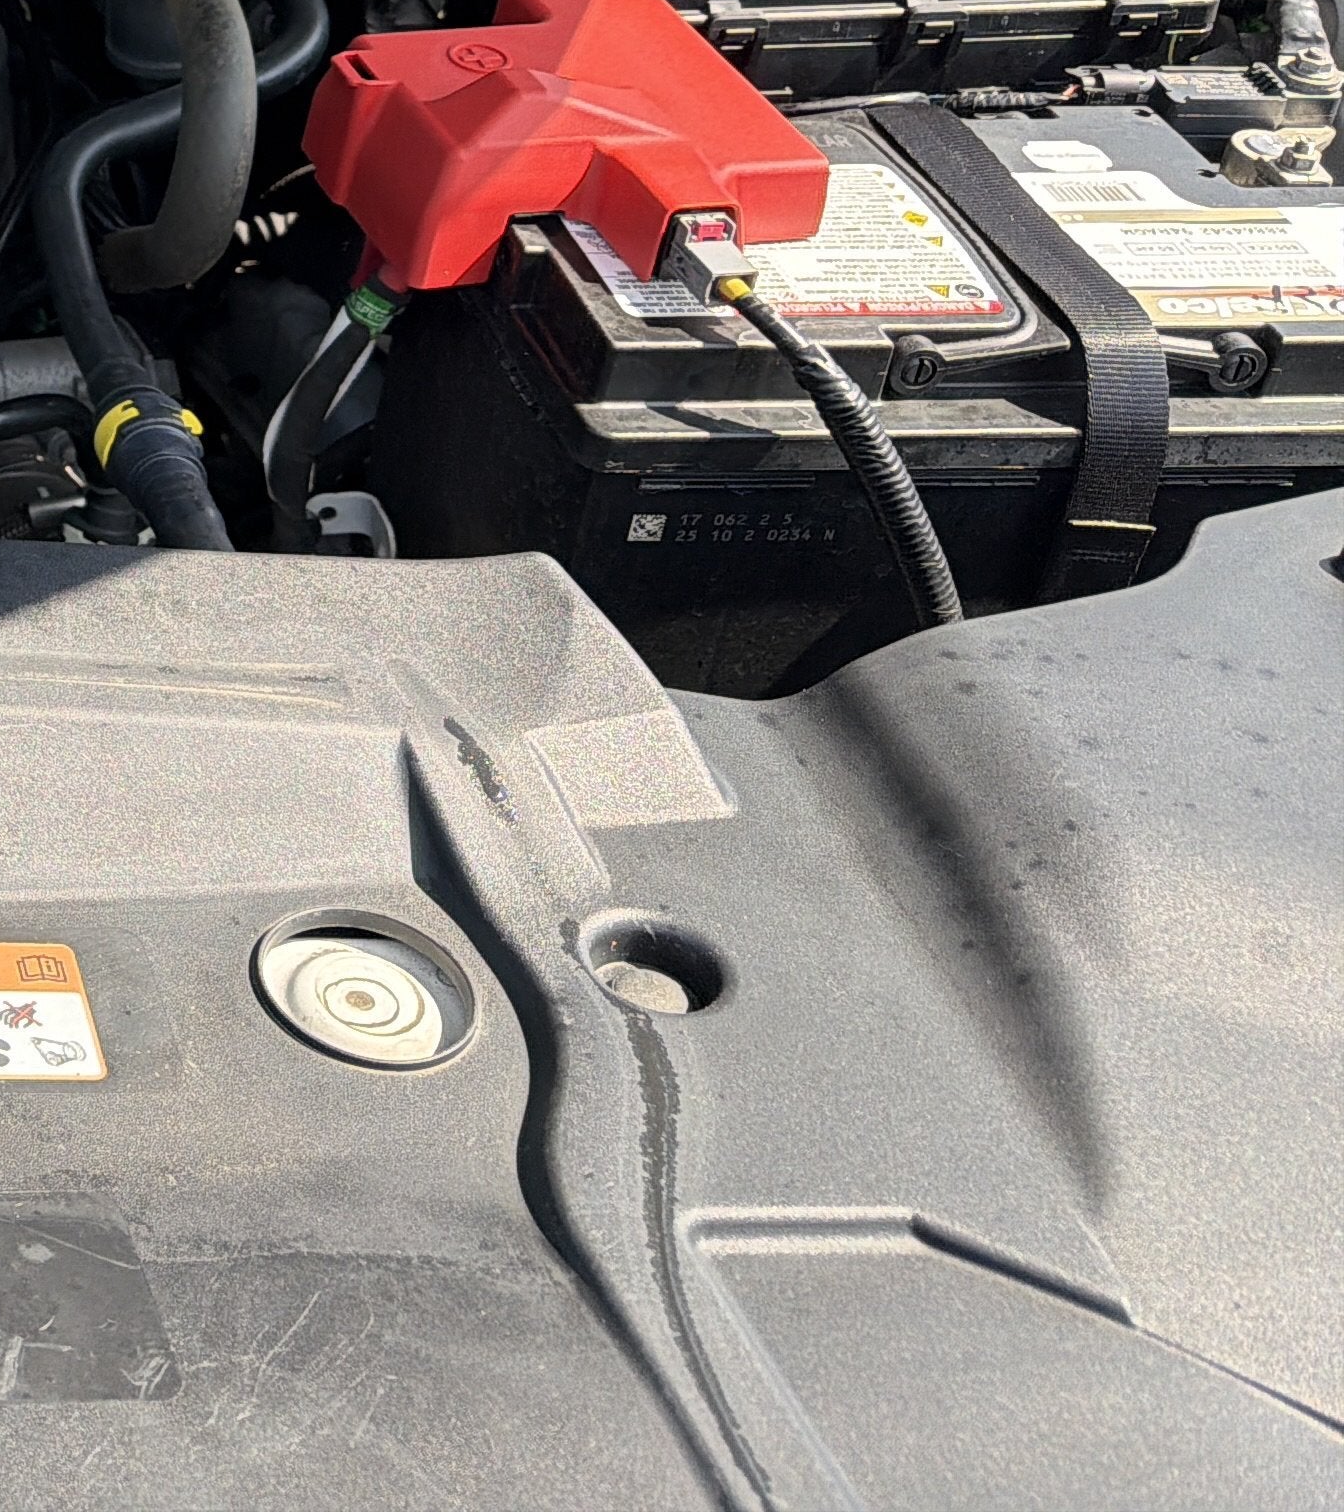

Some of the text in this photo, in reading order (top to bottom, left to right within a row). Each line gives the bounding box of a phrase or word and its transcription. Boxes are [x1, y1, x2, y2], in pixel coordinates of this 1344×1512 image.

[680, 513, 702, 526] 17
[713, 513, 747, 526] 062
[758, 513, 770, 526] 2
[674, 529, 698, 542] 25
[711, 529, 733, 542] 10
[743, 529, 756, 542] 2
[823, 529, 836, 542] N
